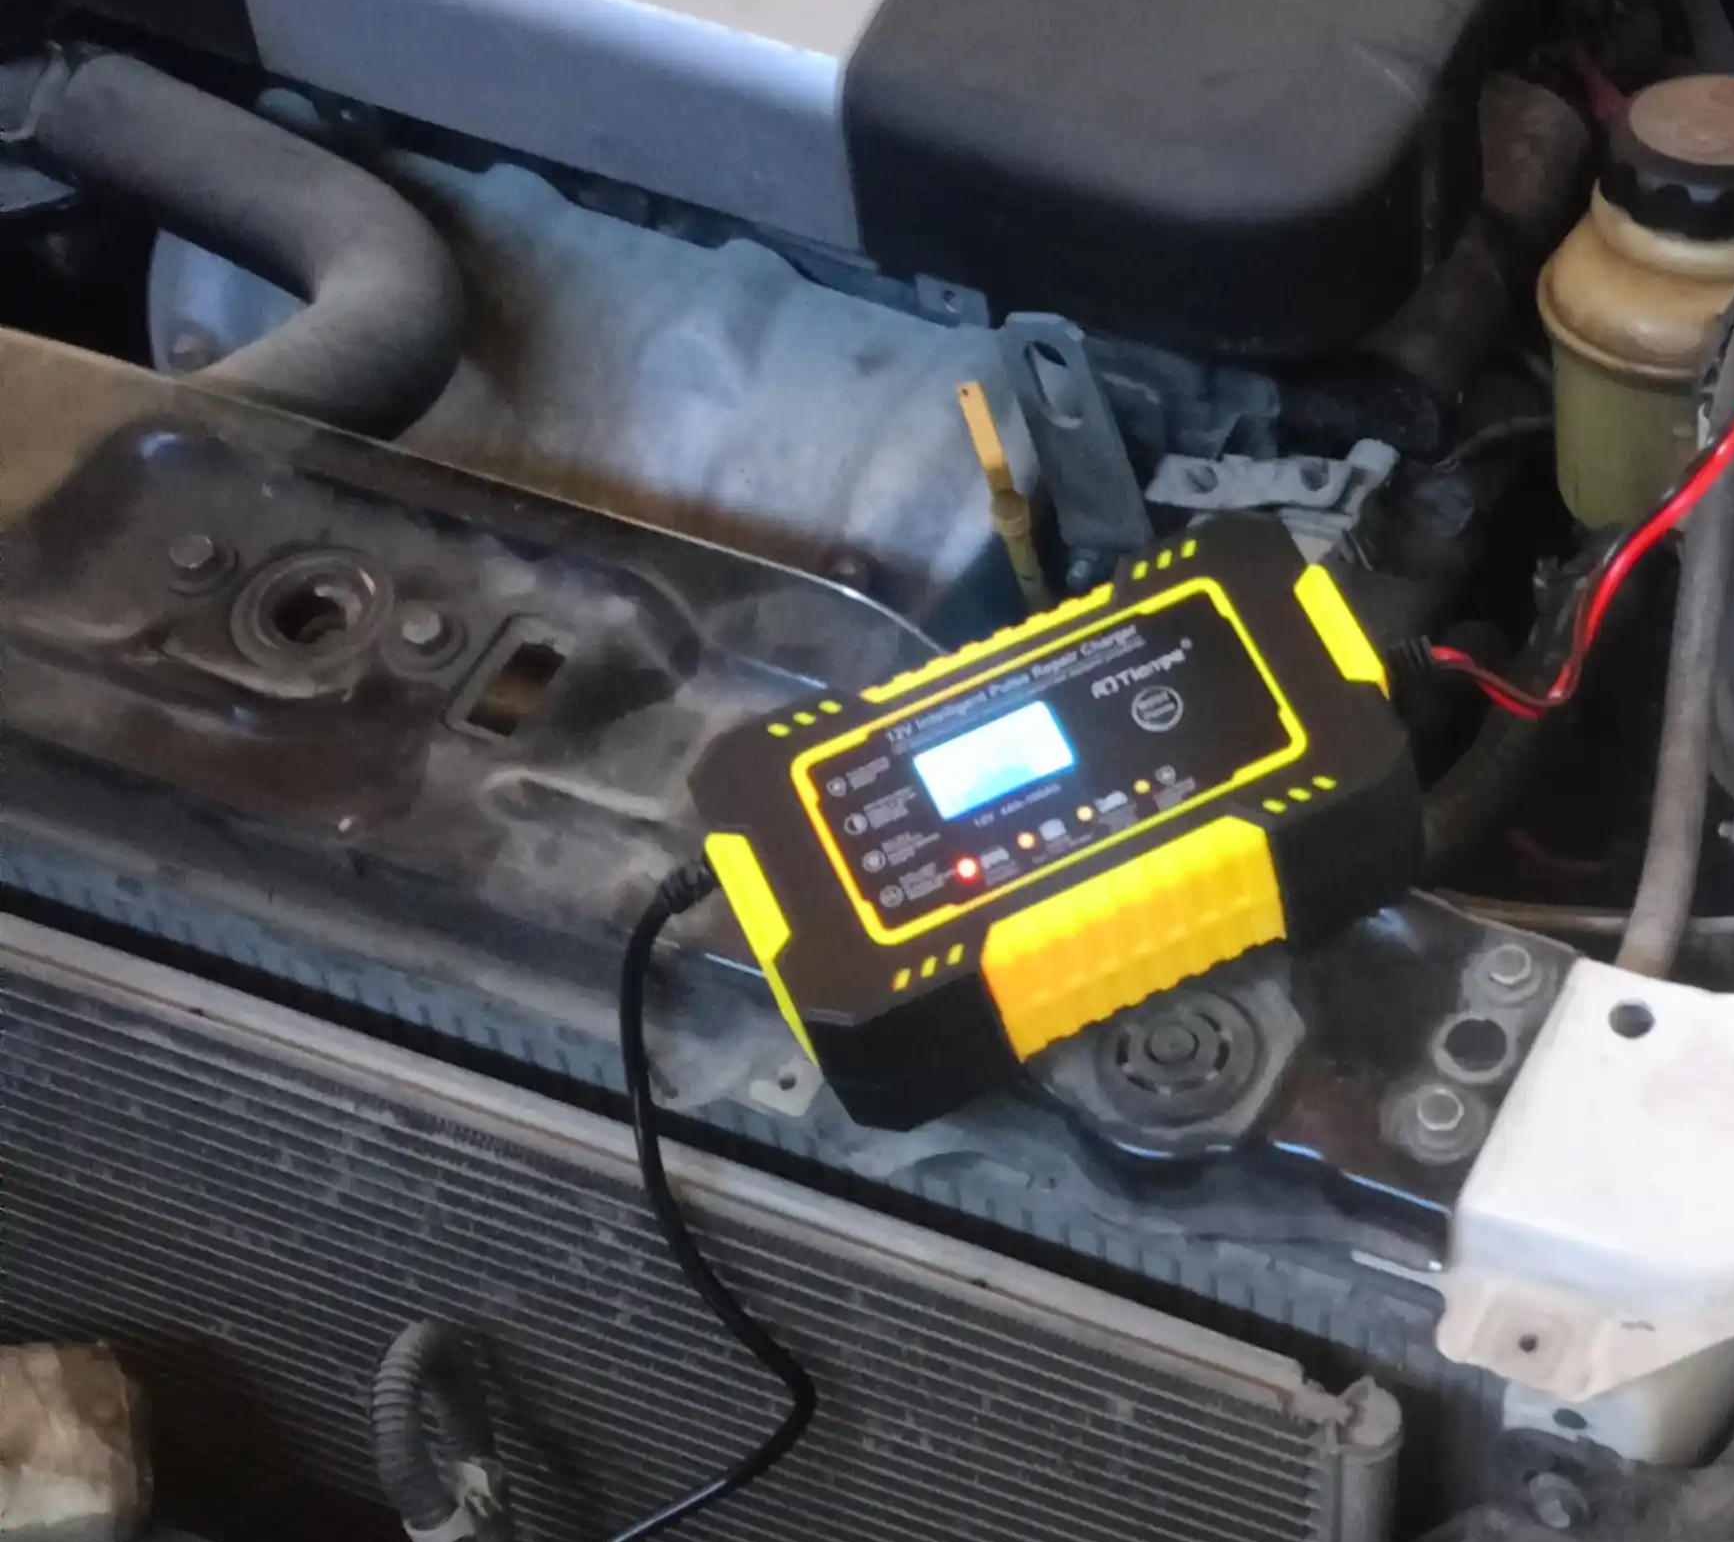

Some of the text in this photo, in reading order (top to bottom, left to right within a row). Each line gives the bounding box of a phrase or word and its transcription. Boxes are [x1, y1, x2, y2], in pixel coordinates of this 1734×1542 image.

[885, 721, 914, 745] 12V
[914, 690, 988, 731] Intelligent
[1030, 650, 1078, 681] Repair
[1079, 623, 1137, 658] Charger
